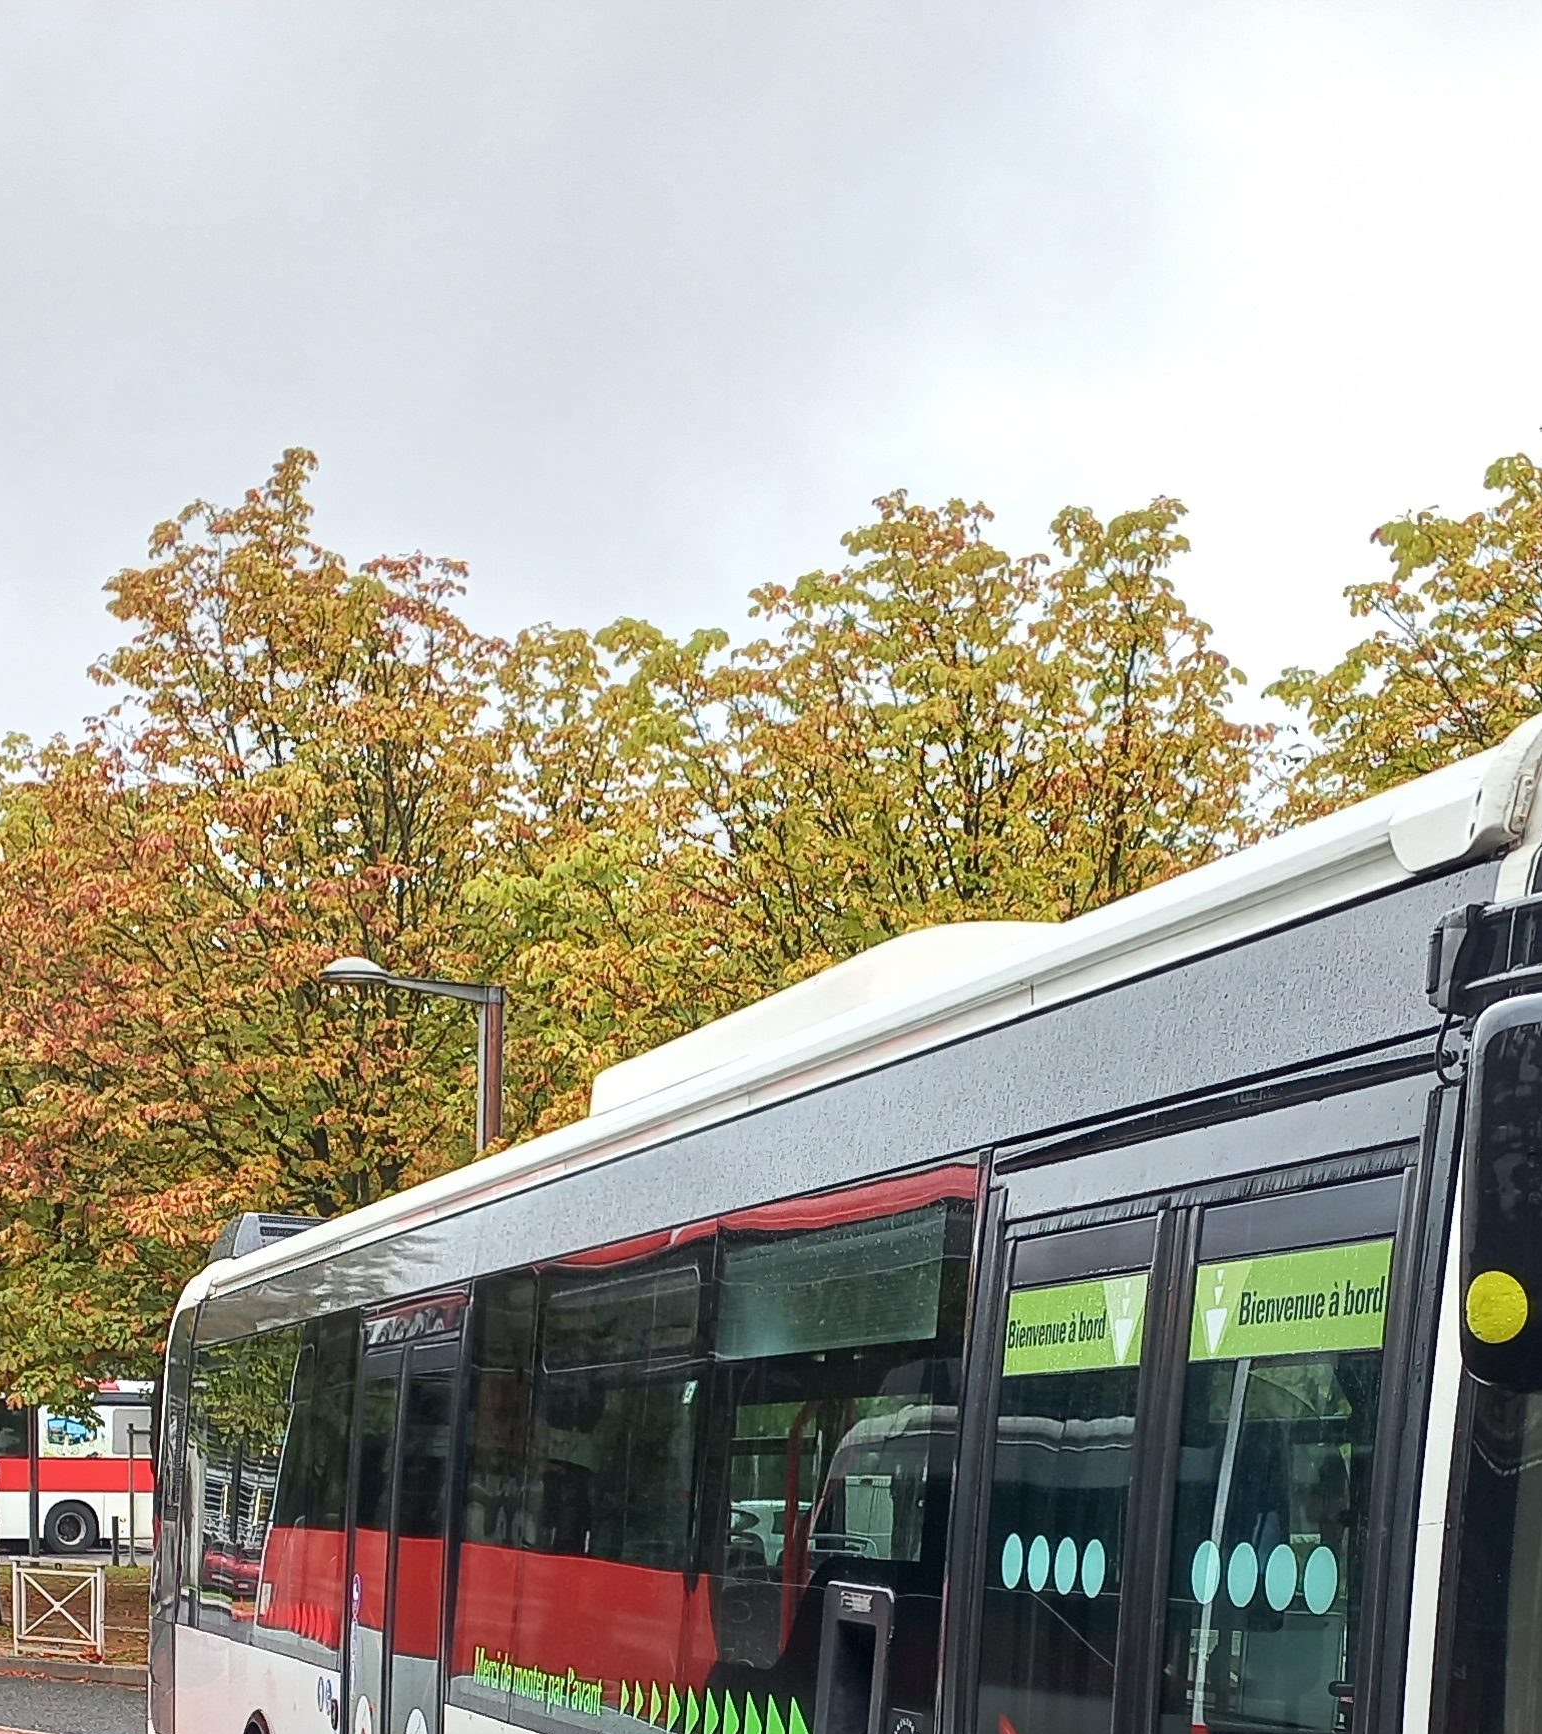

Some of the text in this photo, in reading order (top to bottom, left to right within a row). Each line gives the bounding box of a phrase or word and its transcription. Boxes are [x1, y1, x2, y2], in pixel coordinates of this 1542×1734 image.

[1238, 1275, 1386, 1326] Bienvenue à bord
[1007, 1308, 1108, 1349] Bienvenue à bord
[473, 1646, 501, 1690] Merci
[500, 1652, 512, 1692] de
[512, 1664, 547, 1703] monter
[546, 1674, 566, 1714] par
